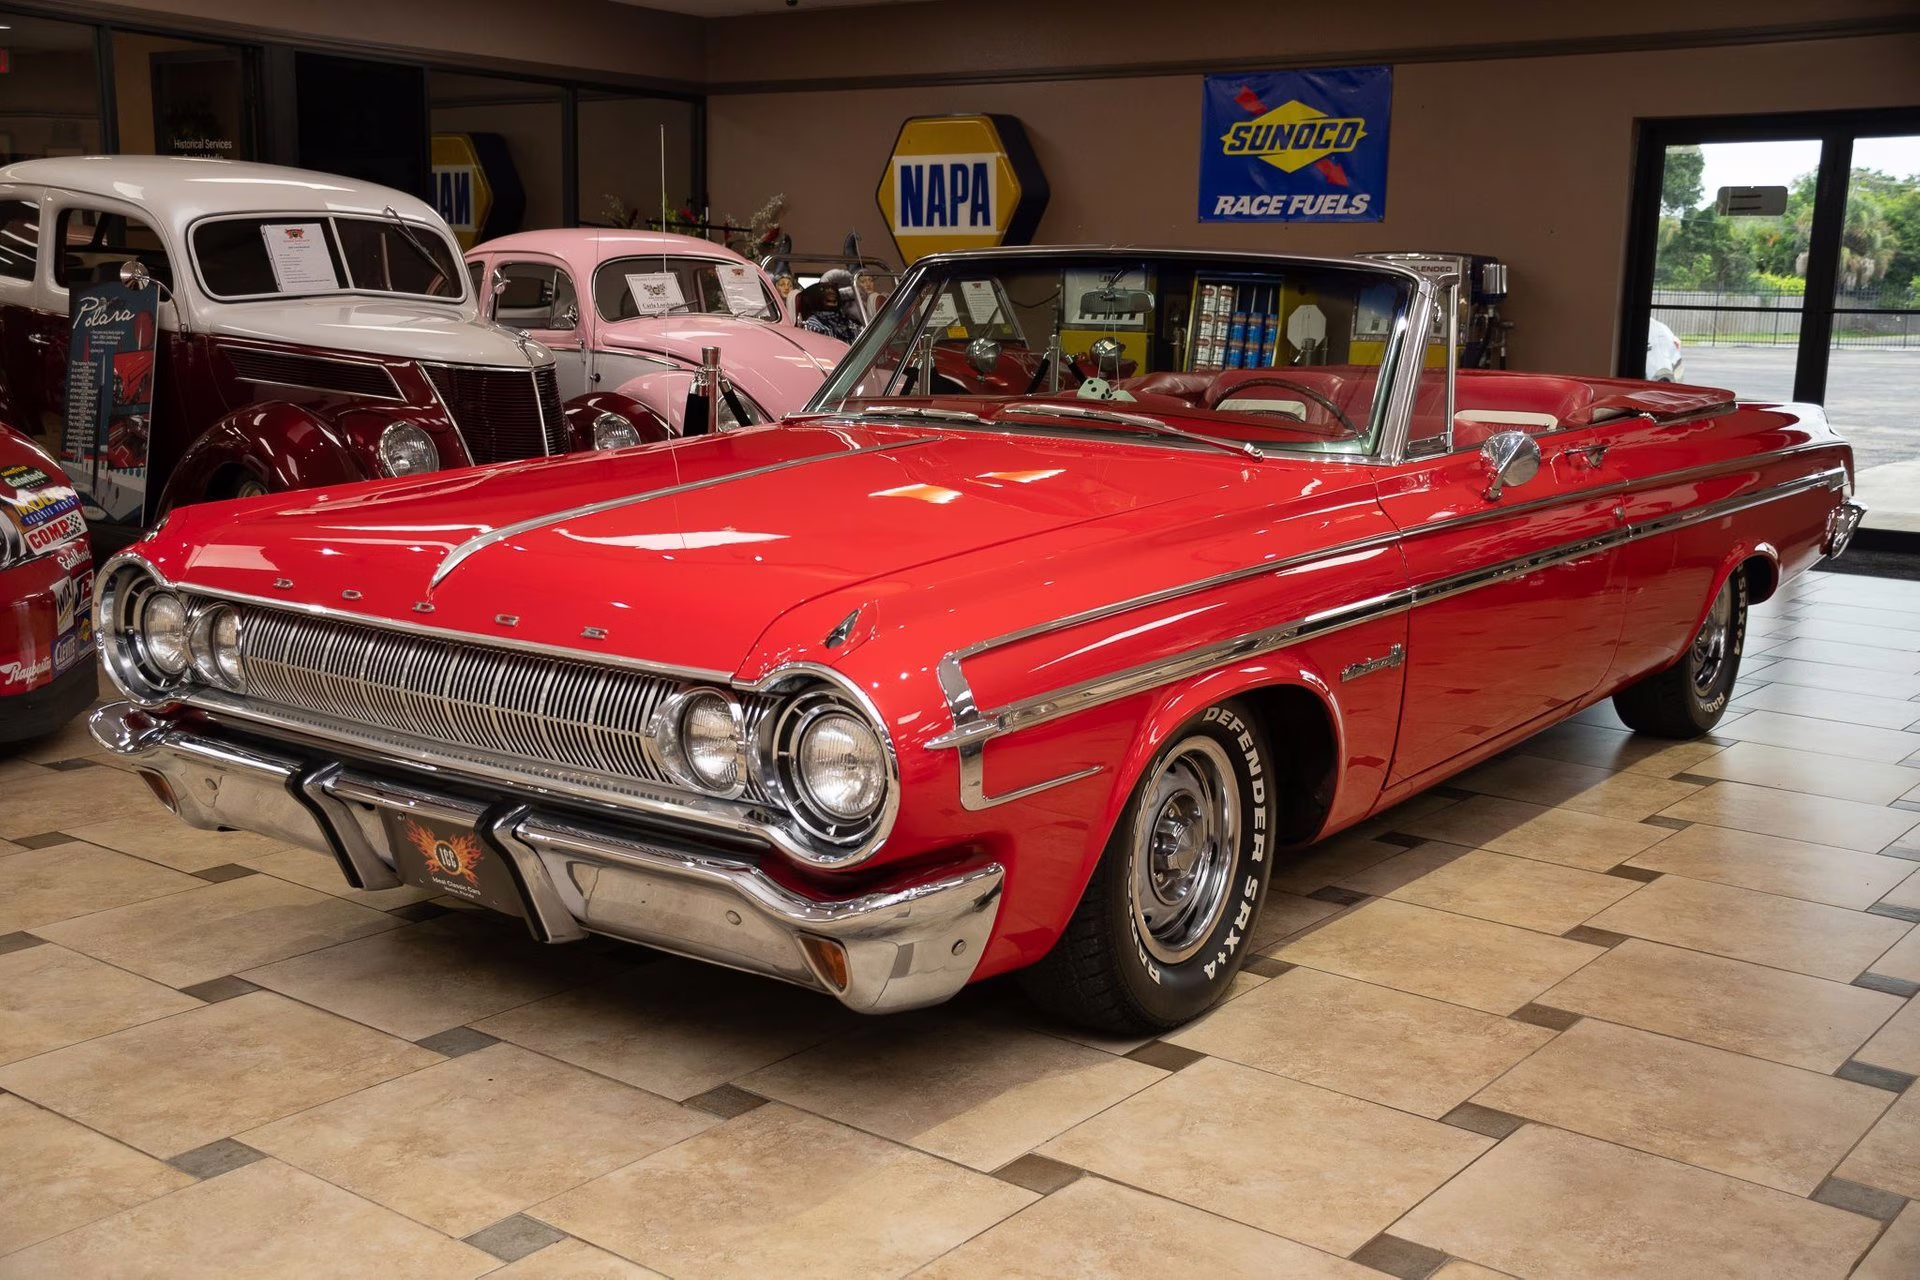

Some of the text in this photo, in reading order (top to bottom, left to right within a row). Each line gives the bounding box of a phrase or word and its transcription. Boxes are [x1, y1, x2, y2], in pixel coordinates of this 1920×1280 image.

[174, 137, 233, 149] Historical Services
[1227, 122, 1361, 151] SUNOCO
[900, 162, 991, 228] NAPA
[1213, 194, 1371, 215] RACE FUELS
[1410, 265, 1453, 273] BLENDED
[72, 296, 136, 330] Polara
[28, 519, 70, 550] COMP
[62, 527, 82, 540] CAMS
[273, 577, 609, 641] DODGE
[438, 847, 457, 868] ICC
[1202, 706, 1266, 980] DEFENDER SRX+4
